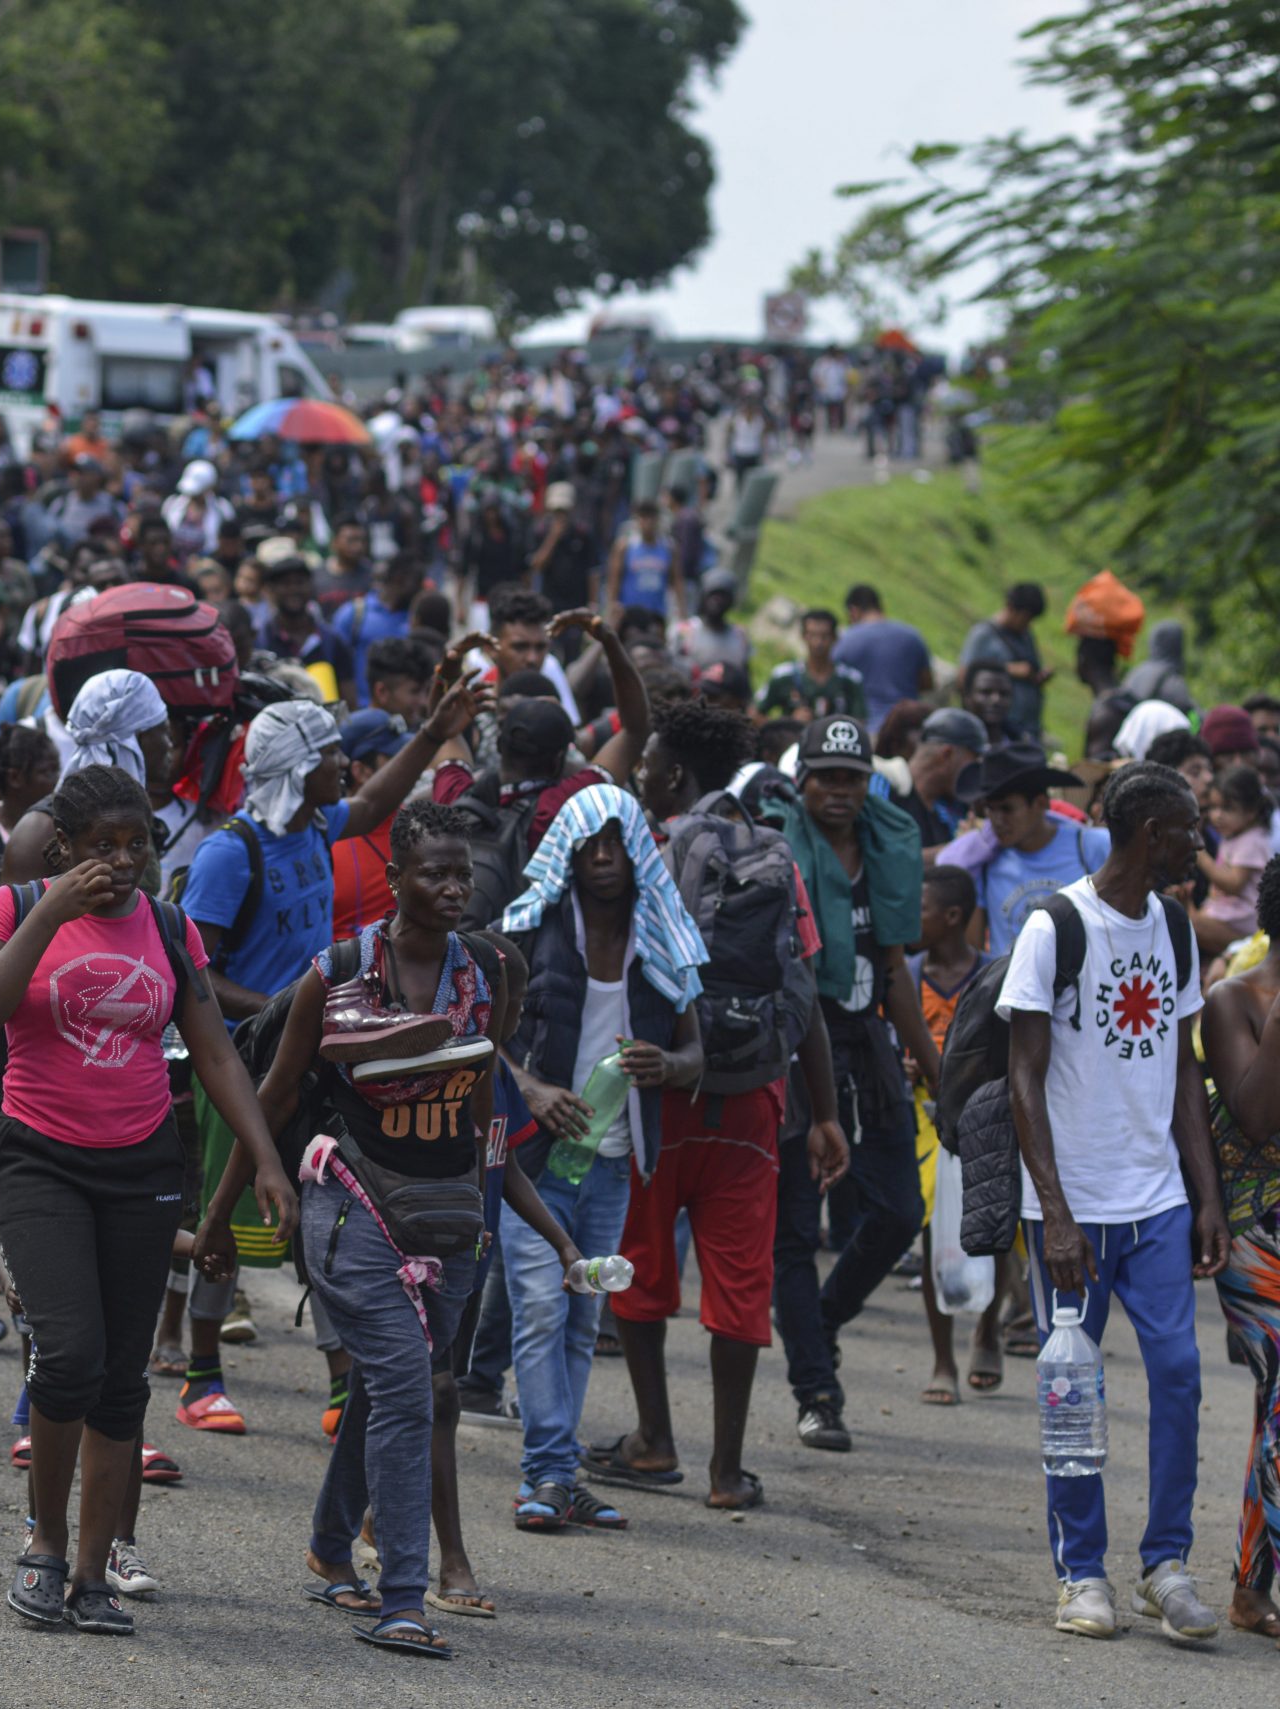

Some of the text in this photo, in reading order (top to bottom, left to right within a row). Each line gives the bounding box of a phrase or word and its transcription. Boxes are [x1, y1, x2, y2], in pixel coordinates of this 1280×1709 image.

[1096, 951, 1175, 1060] CANNON BEACH
[381, 1101, 463, 1141] OUT
